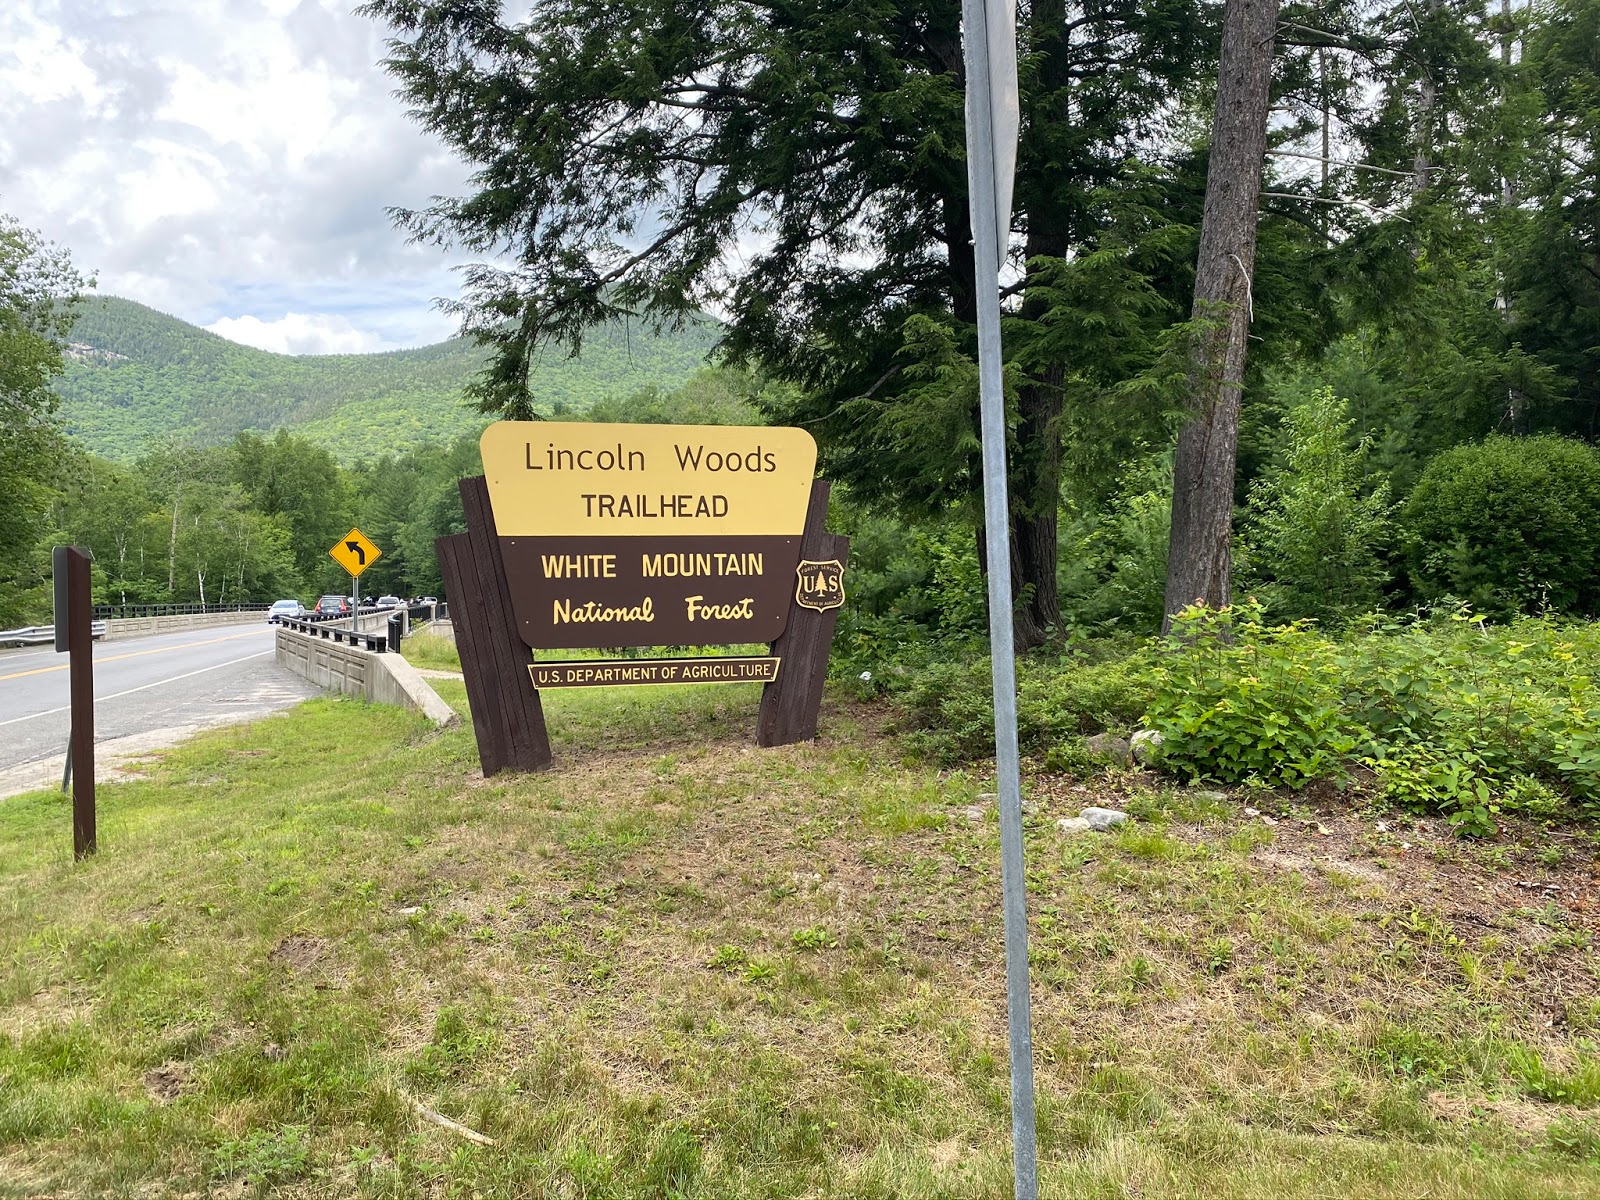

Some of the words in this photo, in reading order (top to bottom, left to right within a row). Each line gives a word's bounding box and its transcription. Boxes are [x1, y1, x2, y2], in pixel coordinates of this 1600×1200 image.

[526, 442, 645, 471] Lincoln
[674, 444, 776, 472] Woods
[581, 494, 728, 518] TRAILHEAD
[541, 554, 617, 578] WHITE
[642, 553, 763, 577] MOUNTAIN
[553, 596, 655, 625] National
[684, 595, 754, 622] Forest
[538, 670, 563, 683] U.S.
[567, 667, 658, 682] DEPARTMENT
[661, 666, 678, 679] OF
[682, 664, 771, 678] AGRICULTURE
